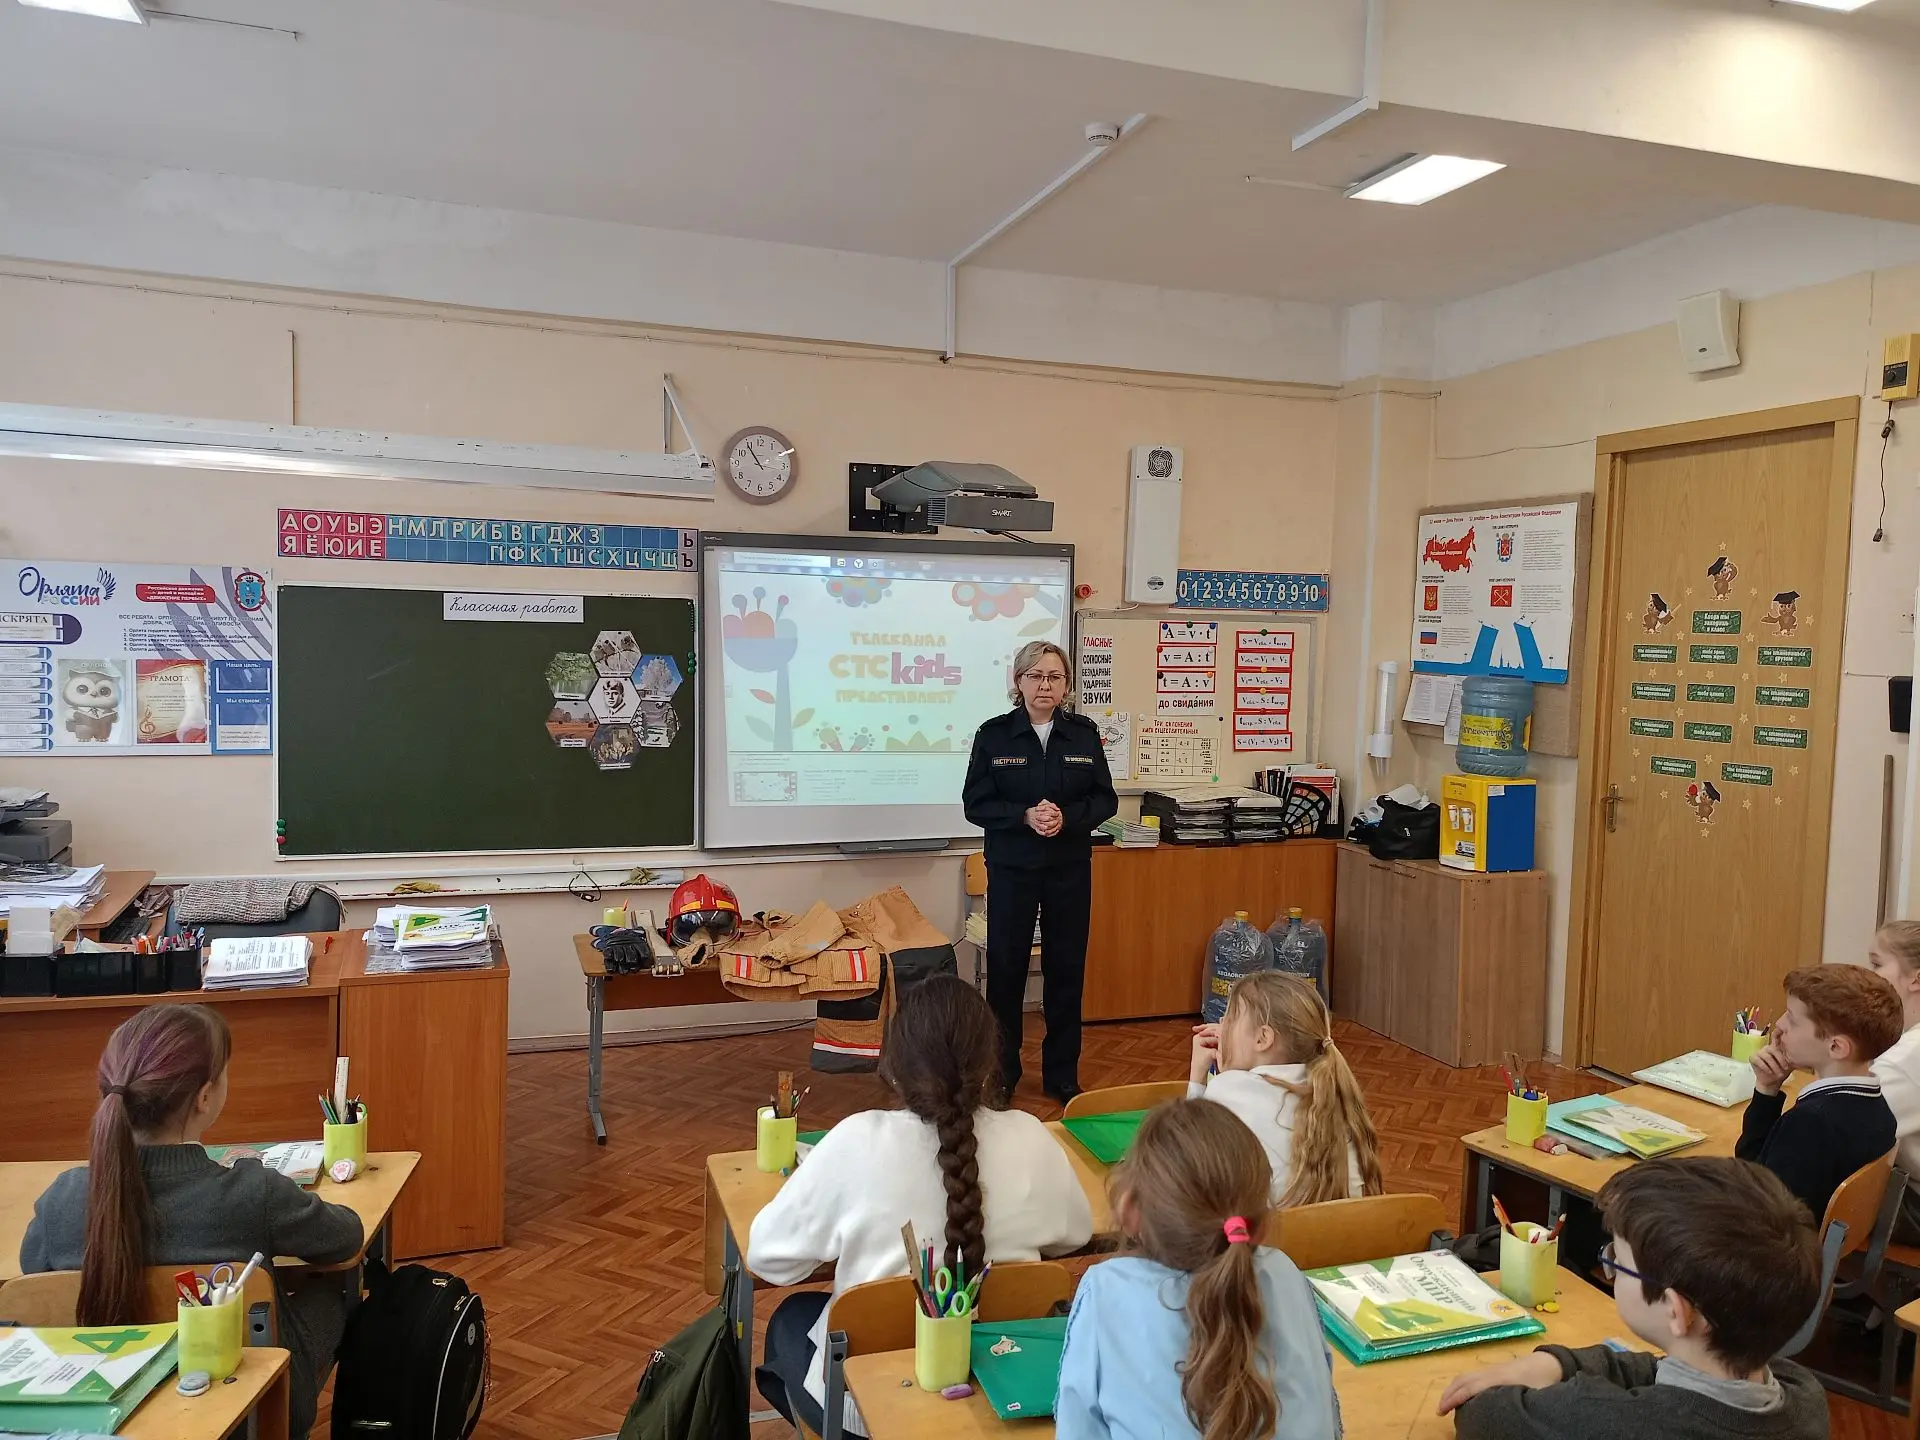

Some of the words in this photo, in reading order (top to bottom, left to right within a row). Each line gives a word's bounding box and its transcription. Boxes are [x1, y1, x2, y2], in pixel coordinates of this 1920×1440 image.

[756, 439, 765, 447] 12
[738, 449, 746, 457] 10
[747, 480, 752, 488] 7
[19, 566, 100, 602] Орлята
[1179, 580, 1188, 598] 0
[1191, 581, 1198, 599] 1
[1203, 581, 1212, 599] 2
[1215, 582, 1224, 600] 3
[1227, 582, 1237, 600] 4
[1241, 583, 1249, 600] 5
[1253, 583, 1262, 600] 6
[1266, 583, 1274, 600] 7
[1277, 583, 1286, 601] 8
[1290, 584, 1299, 601] 9
[1302, 584, 1318, 602] 10
[449, 597, 518, 613] Классная
[519, 599, 578, 619] работа
[0, 614, 48, 623] СКРЯТА
[1083, 636, 1113, 648] ГЛАСНЫЕ
[1082, 679, 1112, 690] УДАРНЫЕ
[1082, 691, 1112, 705] ЗВУКИ
[1158, 700, 1170, 709] до
[1409, 1255, 1477, 1312] Окружающий
[1412, 1275, 1454, 1305] МИР
[72, 1328, 151, 1354] 4
